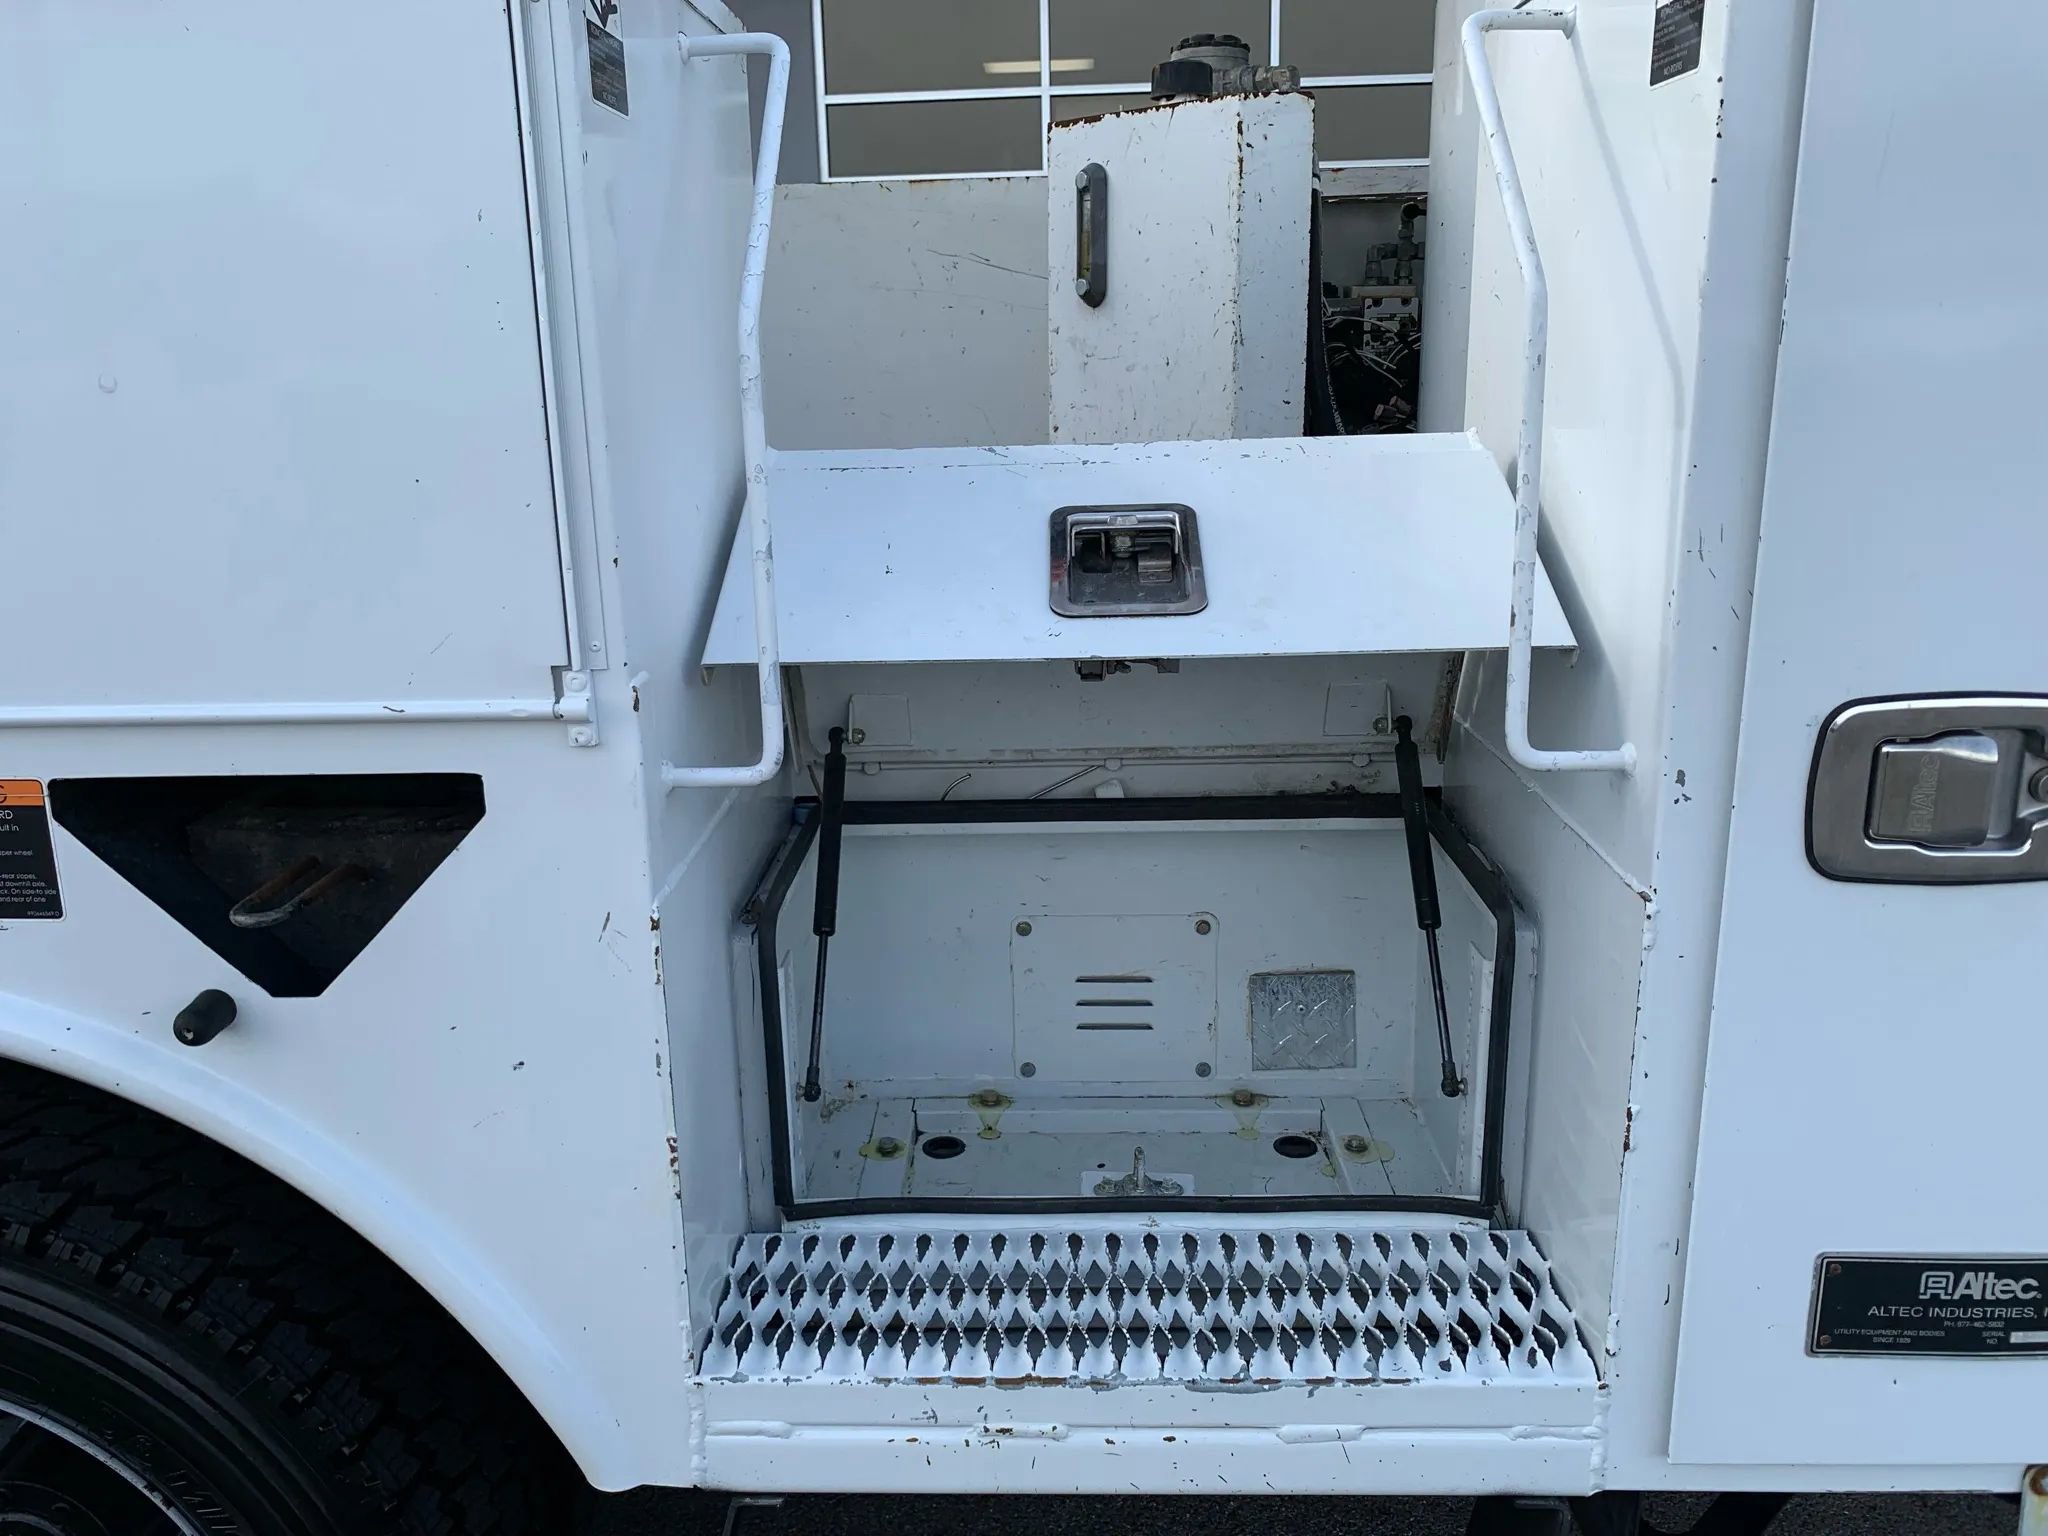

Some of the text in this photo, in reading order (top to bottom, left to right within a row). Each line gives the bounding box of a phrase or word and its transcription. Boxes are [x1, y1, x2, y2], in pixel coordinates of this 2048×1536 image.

[1953, 1271, 2040, 1300] Altec
[1867, 1306, 1924, 1318] ALTEC
[1929, 1306, 2038, 1319] INDUSTRIES,
